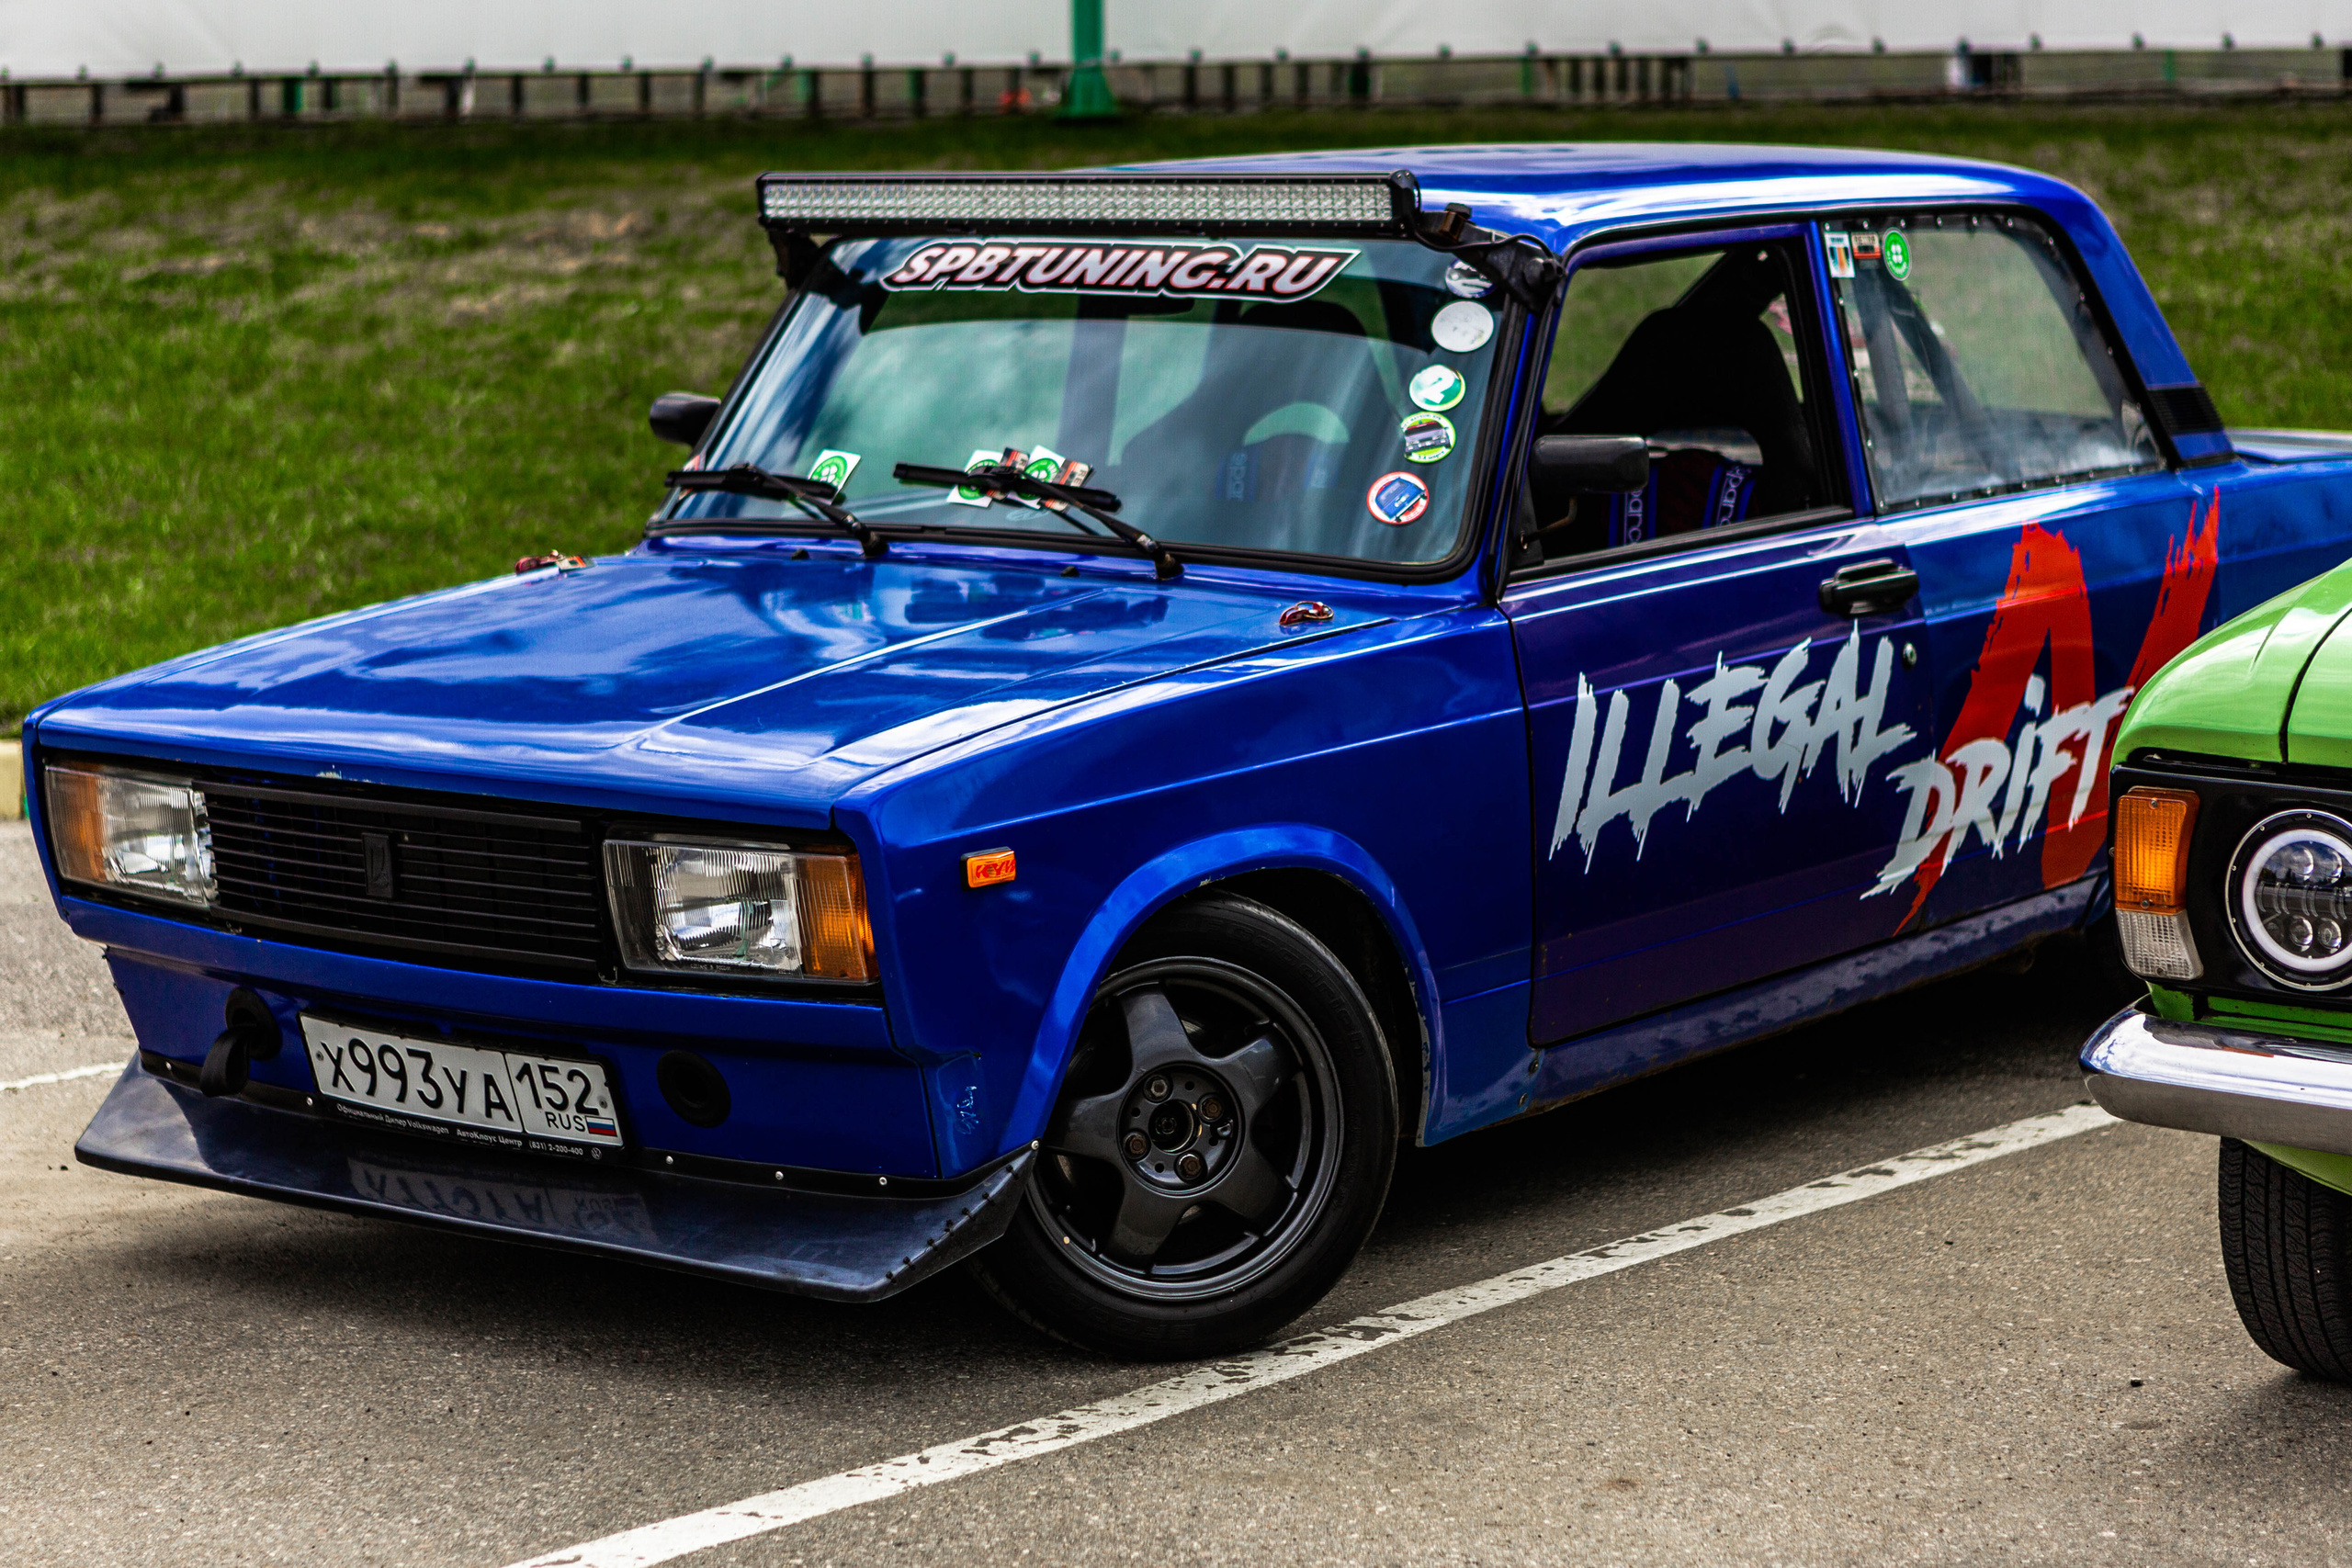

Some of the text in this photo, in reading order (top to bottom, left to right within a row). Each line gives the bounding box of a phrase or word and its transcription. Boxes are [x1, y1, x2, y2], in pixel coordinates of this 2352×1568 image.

[892, 244, 1339, 294] SPBTUNING.RU
[1549, 618, 1917, 874] ILLEGAL
[1860, 673, 2135, 900] DRIFT
[514, 1061, 600, 1116] 152
[407, 1118, 449, 1135] Volkswagen
[498, 1135, 523, 1148] Центр
[528, 1139, 547, 1152] (831)
[548, 1143, 583, 1156] 2-200-400
[546, 1111, 586, 1133] RUS
